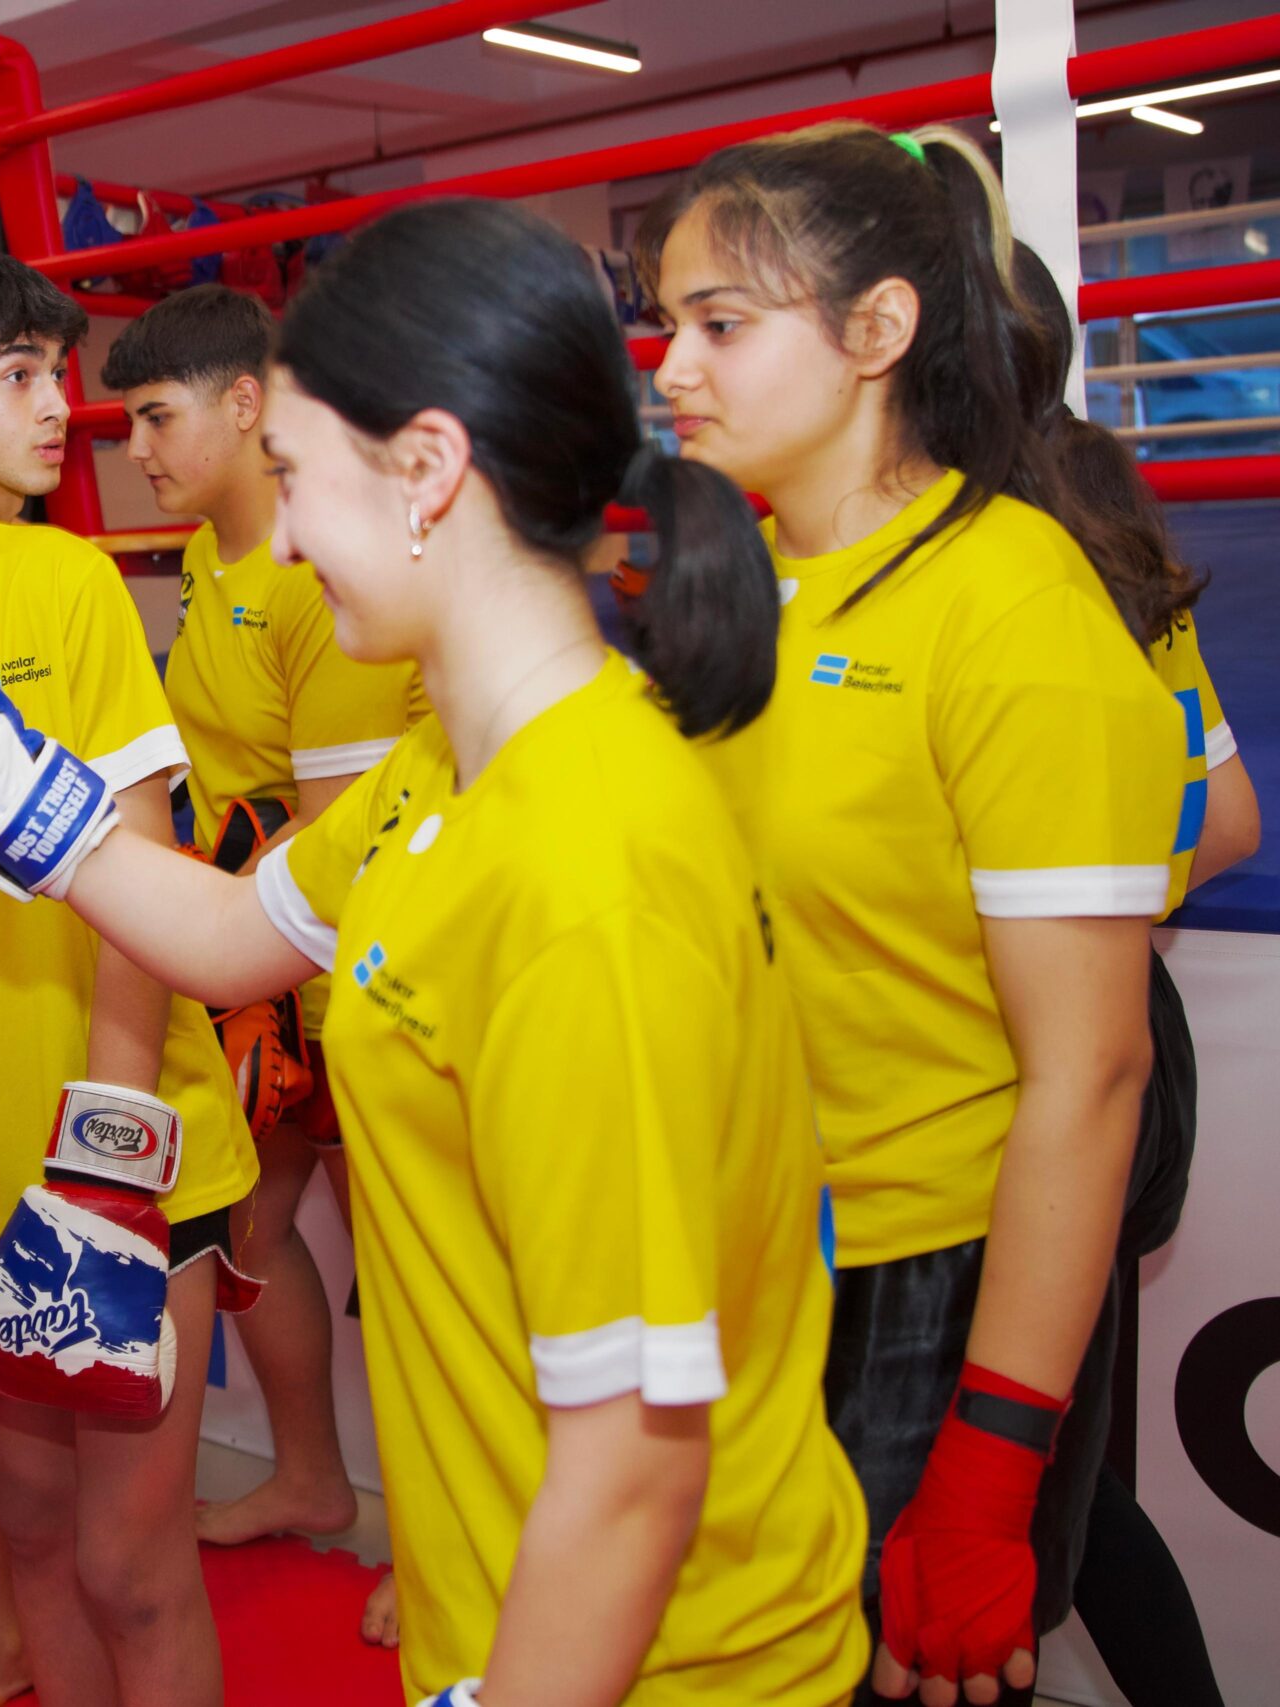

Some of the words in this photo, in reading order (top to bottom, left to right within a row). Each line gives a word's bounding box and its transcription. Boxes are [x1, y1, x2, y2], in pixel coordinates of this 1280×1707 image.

[0, 664, 52, 687] Belediyesi
[4, 816, 45, 862] JUST
[36, 758, 79, 818] TRUST
[27, 777, 91, 864] YOURSELF
[84, 1117, 144, 1153] Fairtex
